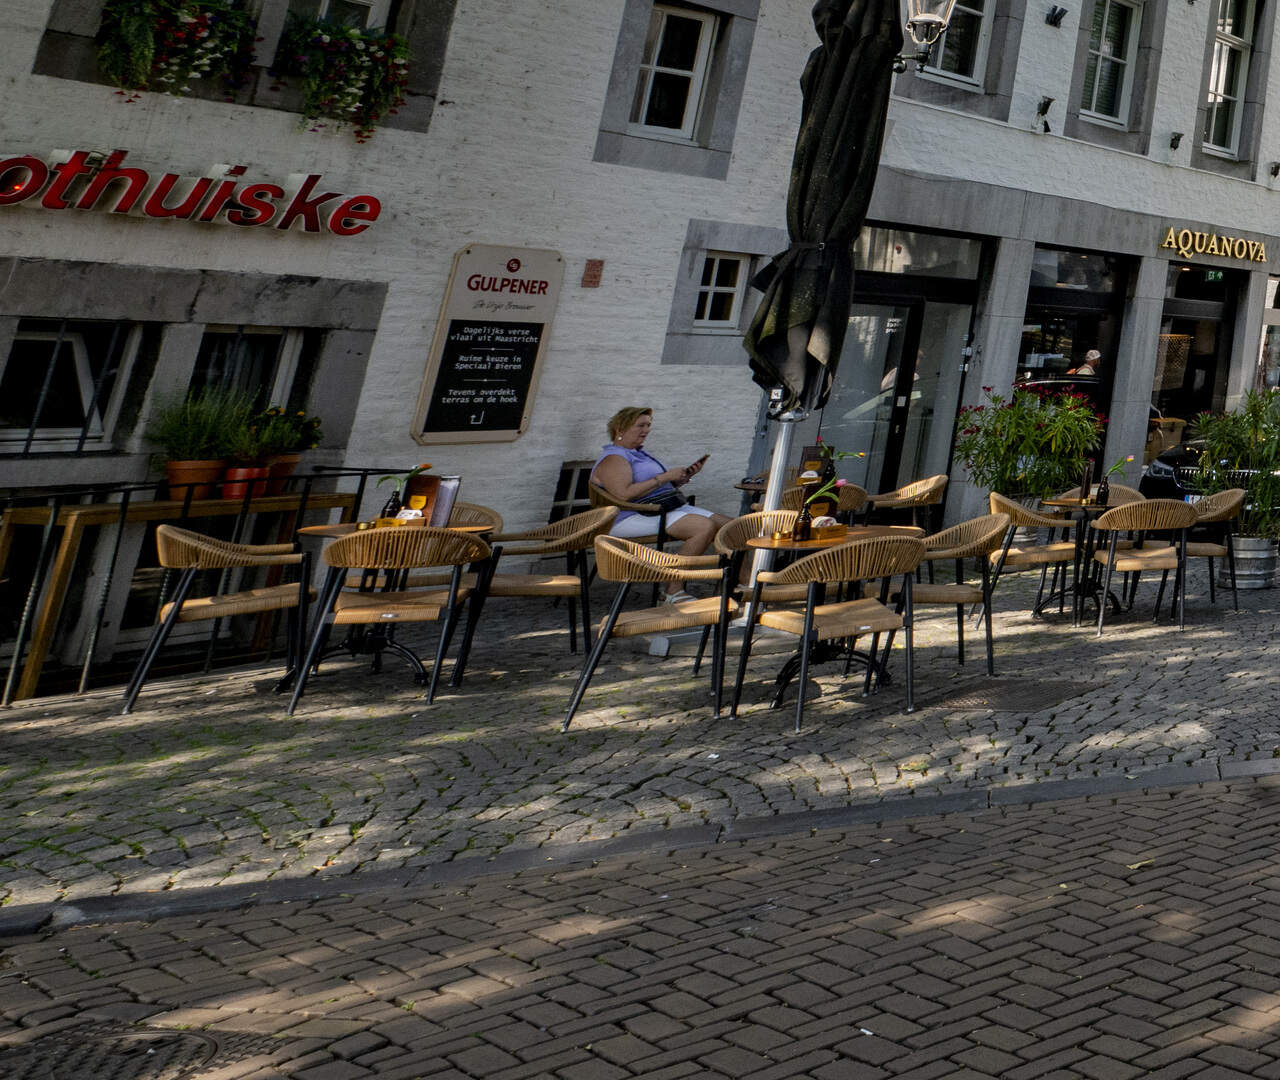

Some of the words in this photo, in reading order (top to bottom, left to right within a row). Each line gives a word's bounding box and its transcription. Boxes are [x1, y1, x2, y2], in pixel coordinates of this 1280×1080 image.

[0, 149, 382, 236] othuiske
[1160, 226, 1268, 263] AQUANOVA
[467, 274, 549, 295] GULPENER
[450, 334, 473, 342] vlaai
[495, 335, 539, 343] Maastricht
[463, 327, 505, 335] Dagelijks
